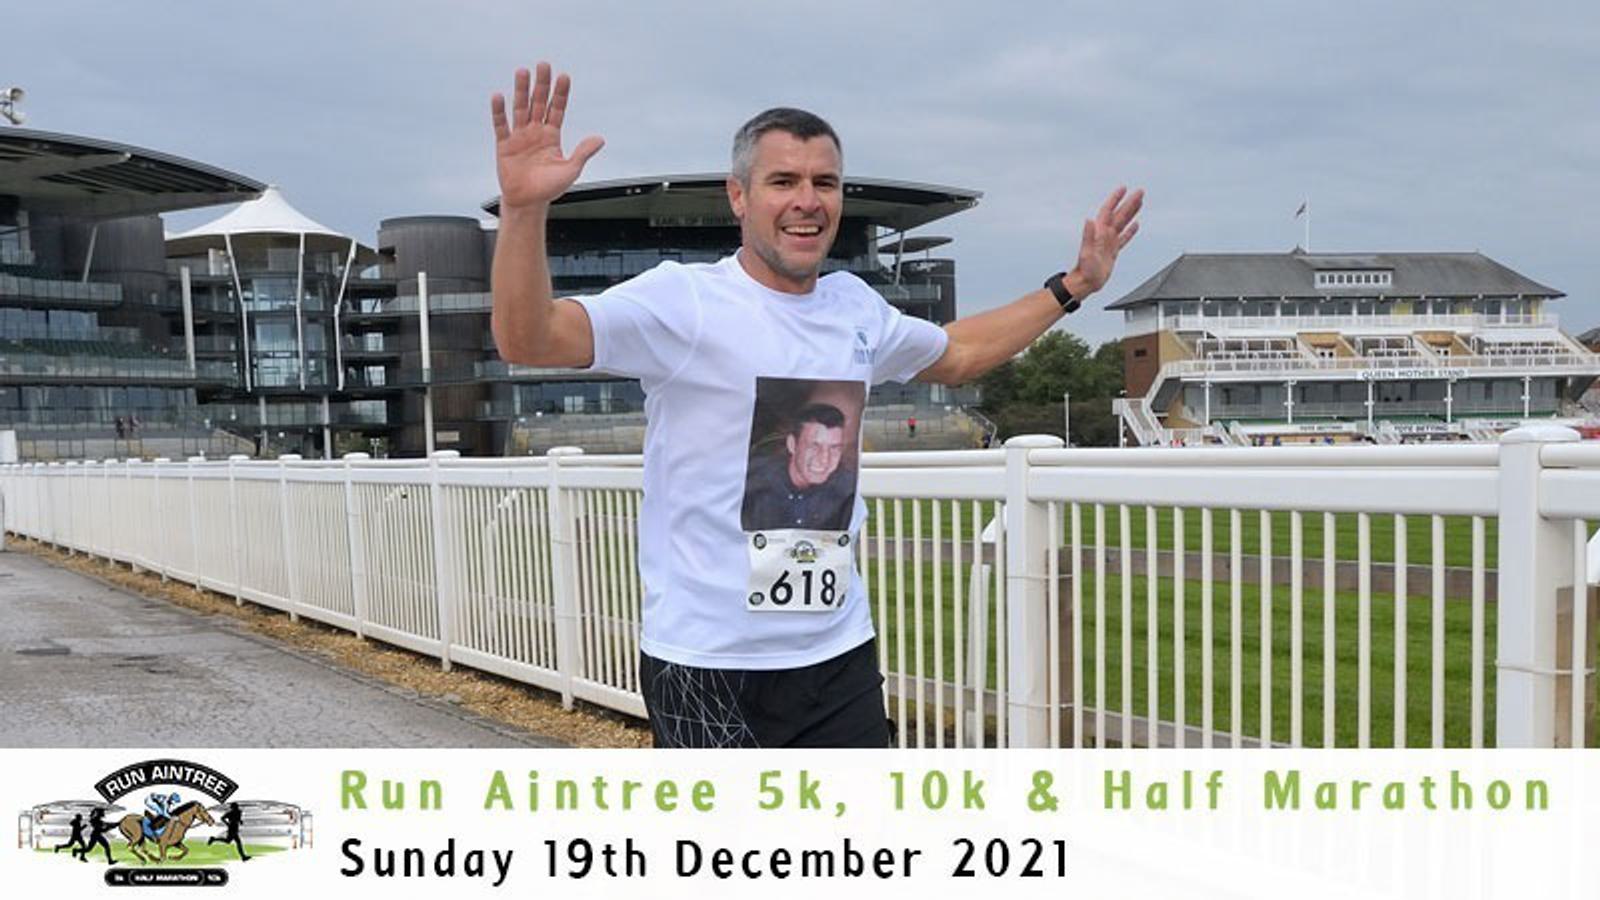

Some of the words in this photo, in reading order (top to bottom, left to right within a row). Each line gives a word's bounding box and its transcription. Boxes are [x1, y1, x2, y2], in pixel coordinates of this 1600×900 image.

[1362, 370, 1395, 379] QUEEN
[1398, 369, 1434, 378] MOTHER
[1438, 368, 1465, 377] STAND
[770, 569, 836, 606] 618
